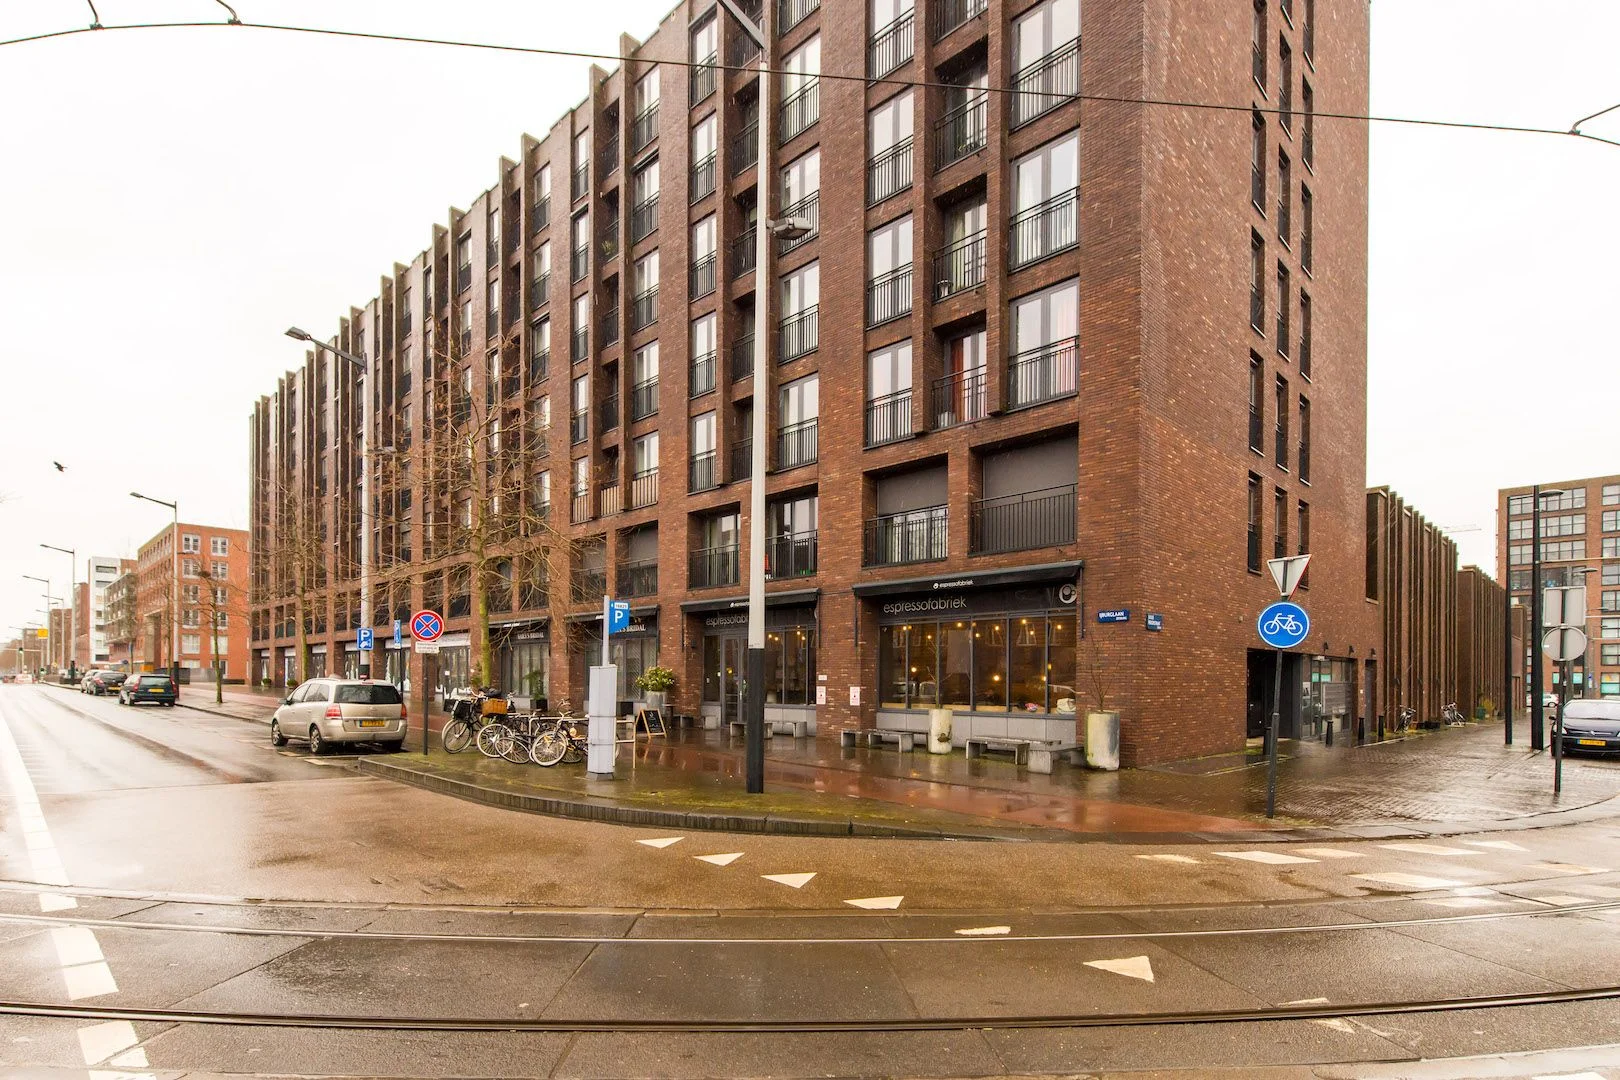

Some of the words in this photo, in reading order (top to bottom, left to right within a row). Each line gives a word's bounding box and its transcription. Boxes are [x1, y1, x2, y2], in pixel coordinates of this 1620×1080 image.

[883, 596, 967, 615] espressofabriek
[614, 610, 624, 623] P
[705, 613, 749, 628] espressofabr
[361, 629, 371, 641] P
